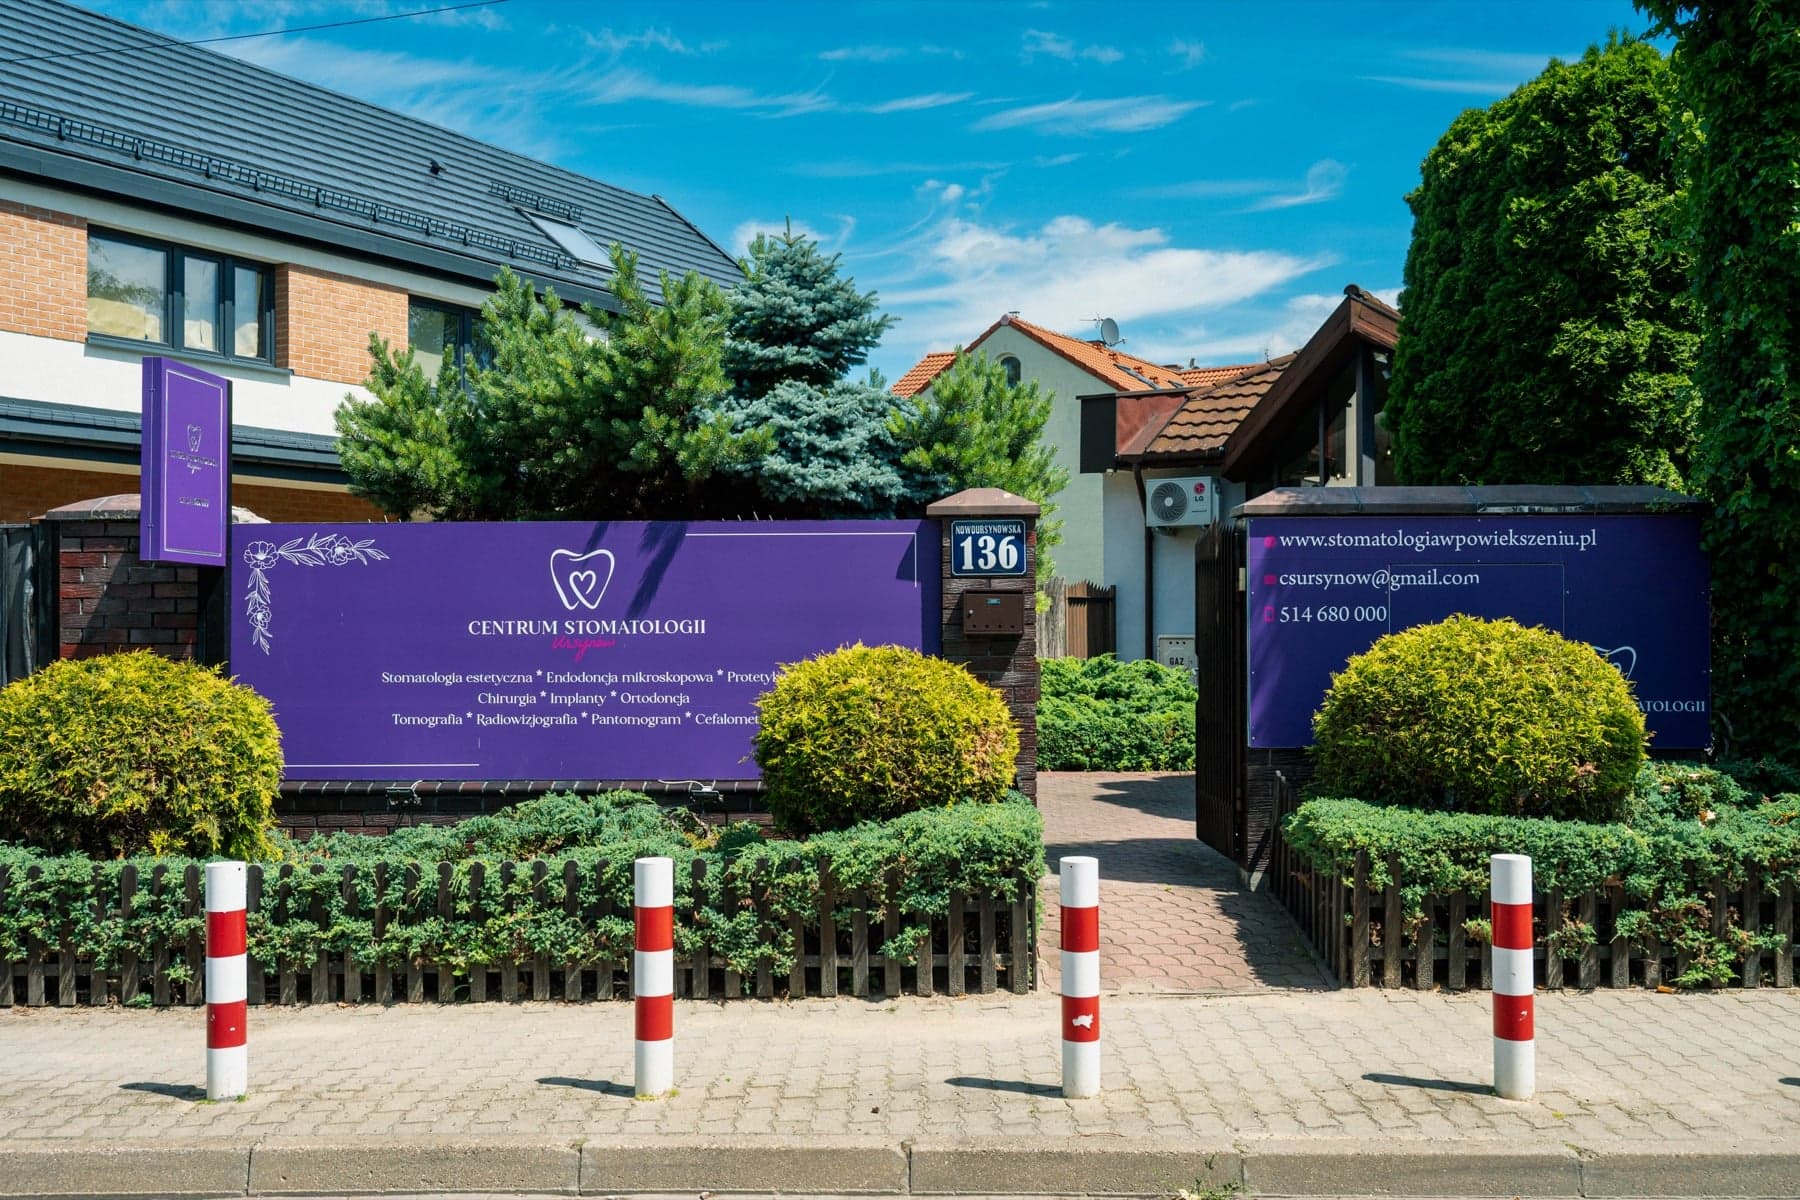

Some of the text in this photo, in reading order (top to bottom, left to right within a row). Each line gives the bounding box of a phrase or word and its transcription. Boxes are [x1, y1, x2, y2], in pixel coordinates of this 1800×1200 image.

[955, 525, 1022, 534] NOWOURSYNOWSKA
[1279, 529, 1597, 552] www.stomatologiawpowiekszeniu.pl
[960, 535, 1018, 570] 136
[1279, 568, 1480, 591] csursynow@gmail.com
[1279, 606, 1387, 623] 514 680 000
[468, 619, 706, 635] CENTRUM STOMATOLOGII
[1169, 657, 1185, 666] GAZ
[381, 671, 463, 686] Stomatologia
[465, 673, 533, 686] estetyczna
[546, 671, 619, 686] Endodoncja
[622, 671, 714, 686] mikroskopowa
[477, 692, 690, 708] Chirurgia Implanty Ortodoncja
[1639, 700, 1705, 712] ATOLOGII
[391, 713, 759, 728] Tomografia Radiowizjografia Pantomogram Cefalomet
